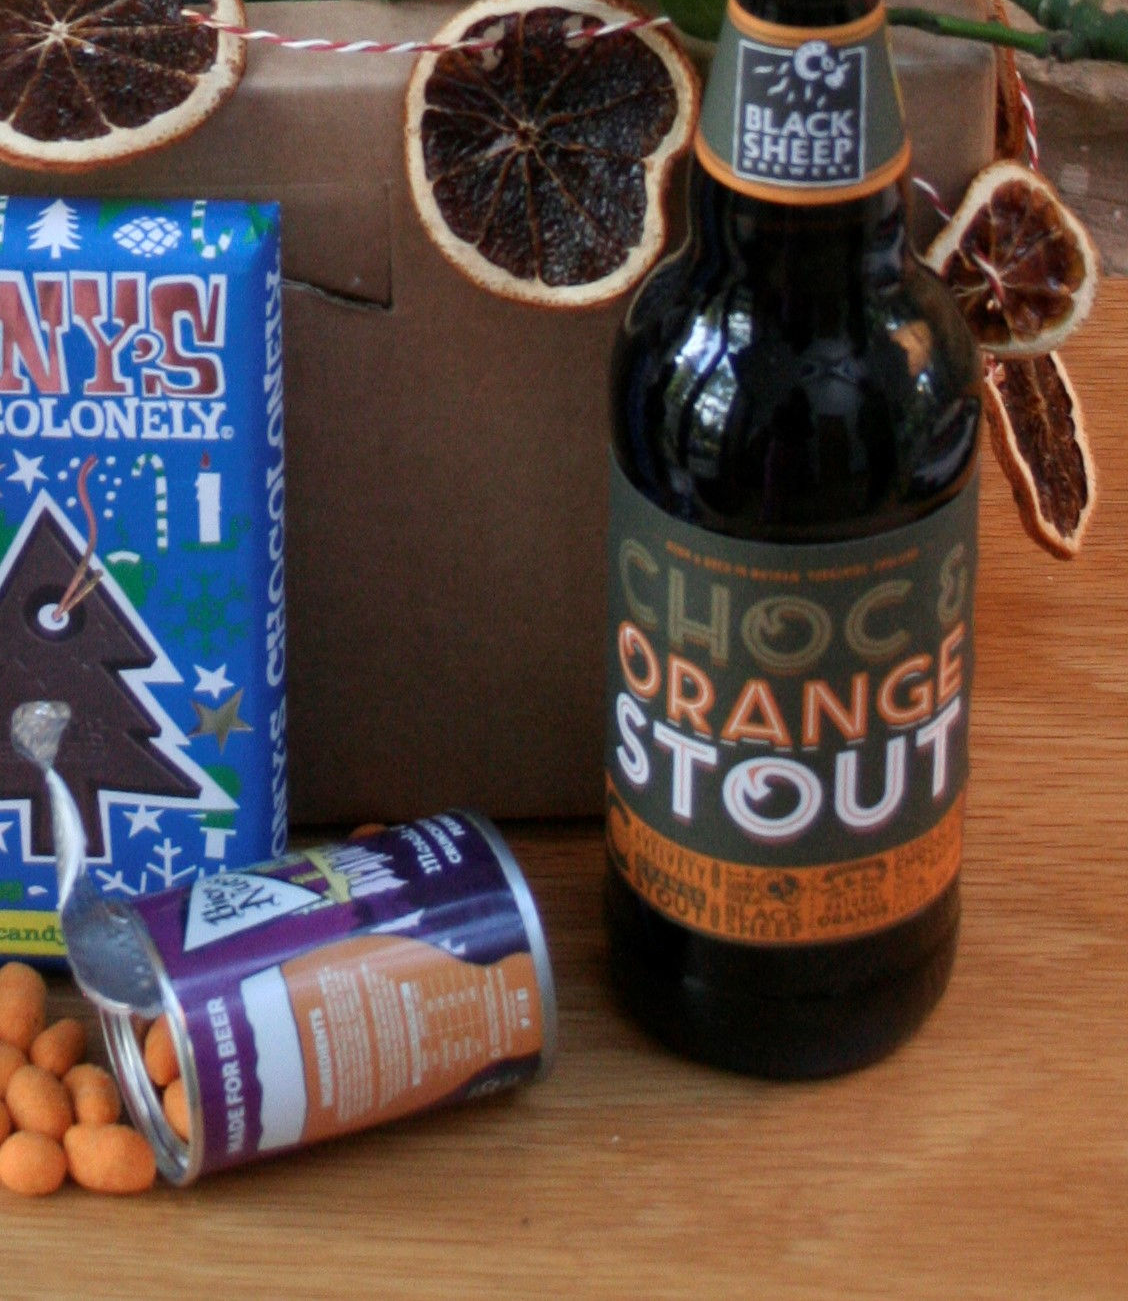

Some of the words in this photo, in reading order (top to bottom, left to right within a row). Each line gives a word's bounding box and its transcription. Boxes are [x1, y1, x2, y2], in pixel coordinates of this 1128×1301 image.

[742, 132, 854, 166] SHEEP
[744, 103, 854, 138] BLACK
[618, 538, 914, 675] CHOC
[617, 620, 967, 752] ORANGE
[269, 694, 288, 859] ONY'S
[615, 691, 963, 842] STOUT
[206, 996, 238, 1060] BEER
[222, 1060, 245, 1106] FOR
[226, 1104, 246, 1155] MADE
